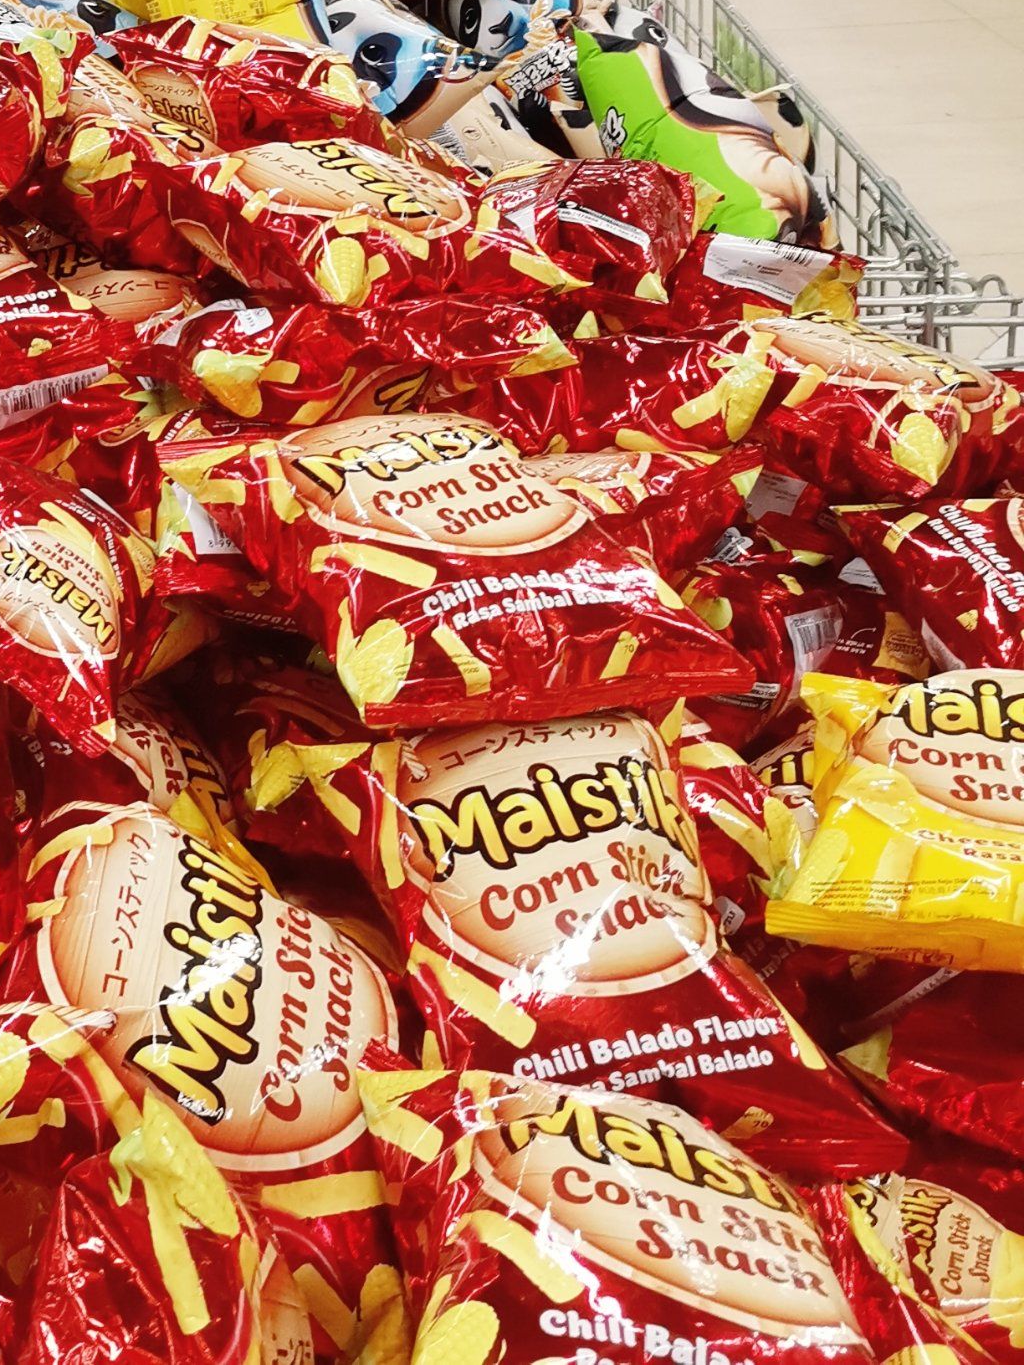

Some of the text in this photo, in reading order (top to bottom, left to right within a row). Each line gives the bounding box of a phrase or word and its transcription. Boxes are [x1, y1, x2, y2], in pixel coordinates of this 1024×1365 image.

[145, 93, 212, 134] aistik
[373, 457, 536, 518] Corn Stic
[441, 485, 552, 534] Snack
[1, 541, 115, 646] Maistik
[421, 579, 484, 618] Chili
[487, 567, 566, 595] Balado
[453, 601, 504, 631] Rasa
[504, 588, 574, 615] Sambal
[439, 720, 618, 771] コーンスティック
[888, 737, 1005, 772] Corn
[407, 756, 699, 883] Maistik
[101, 830, 153, 998] コーンスティック
[480, 840, 687, 931] Corn Stick
[319, 942, 355, 1094] Snack
[258, 996, 310, 1122] Corn
[513, 1015, 781, 1083] Chili Balado Flavor
[608, 1043, 774, 1091] Sambal Balado
[551, 1165, 705, 1225] Corn
[939, 1212, 973, 1296] Corn Stick
[967, 1234, 996, 1284] Snack
